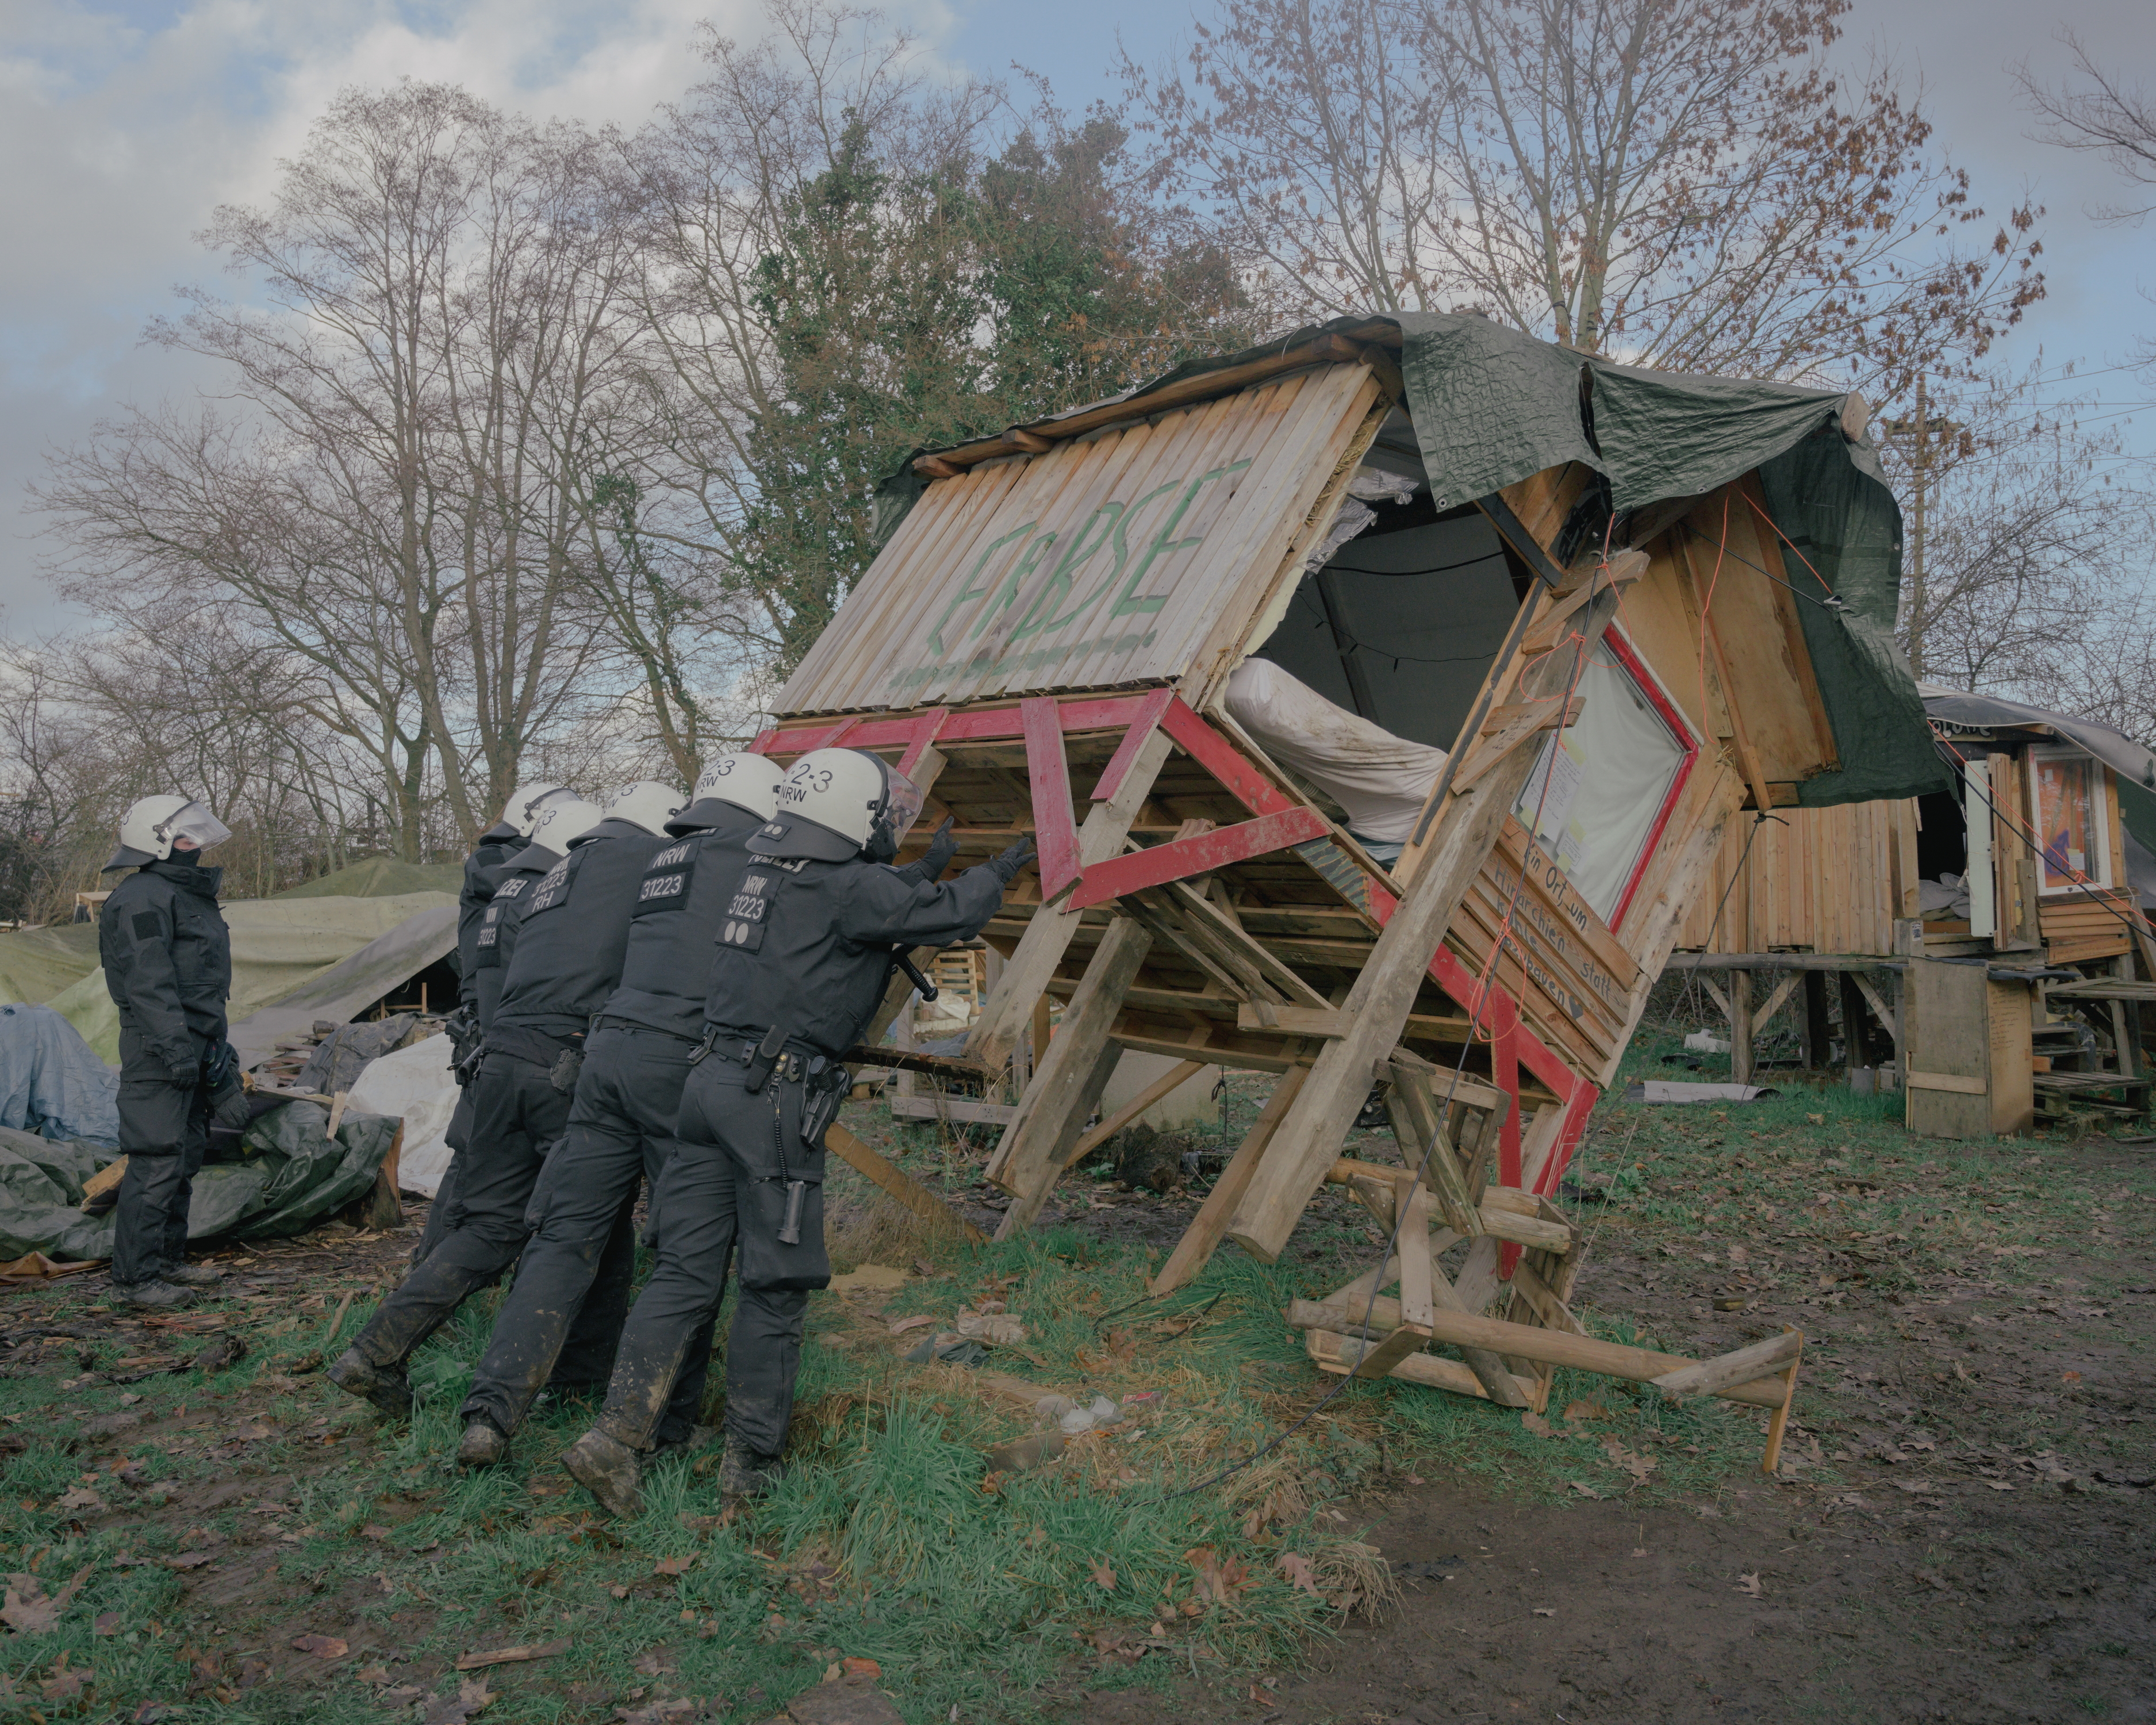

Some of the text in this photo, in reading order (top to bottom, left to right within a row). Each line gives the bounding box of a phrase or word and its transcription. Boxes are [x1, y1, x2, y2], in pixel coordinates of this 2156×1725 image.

[927, 457, 1252, 656] ERBSE
[695, 776, 719, 792] NRW
[780, 785, 807, 803] NRW
[548, 855, 573, 877] NRW
[653, 843, 691, 869] NRW
[531, 870, 567, 898] 31223
[641, 875, 682, 900] 31223
[742, 875, 768, 896] NRW
[532, 891, 554, 913] RH
[728, 894, 765, 919] 31223
[1545, 866, 1567, 907] Ort,
[1570, 902, 1587, 931] um
[486, 907, 498, 923] NRW
[478, 927, 496, 946] 31223
